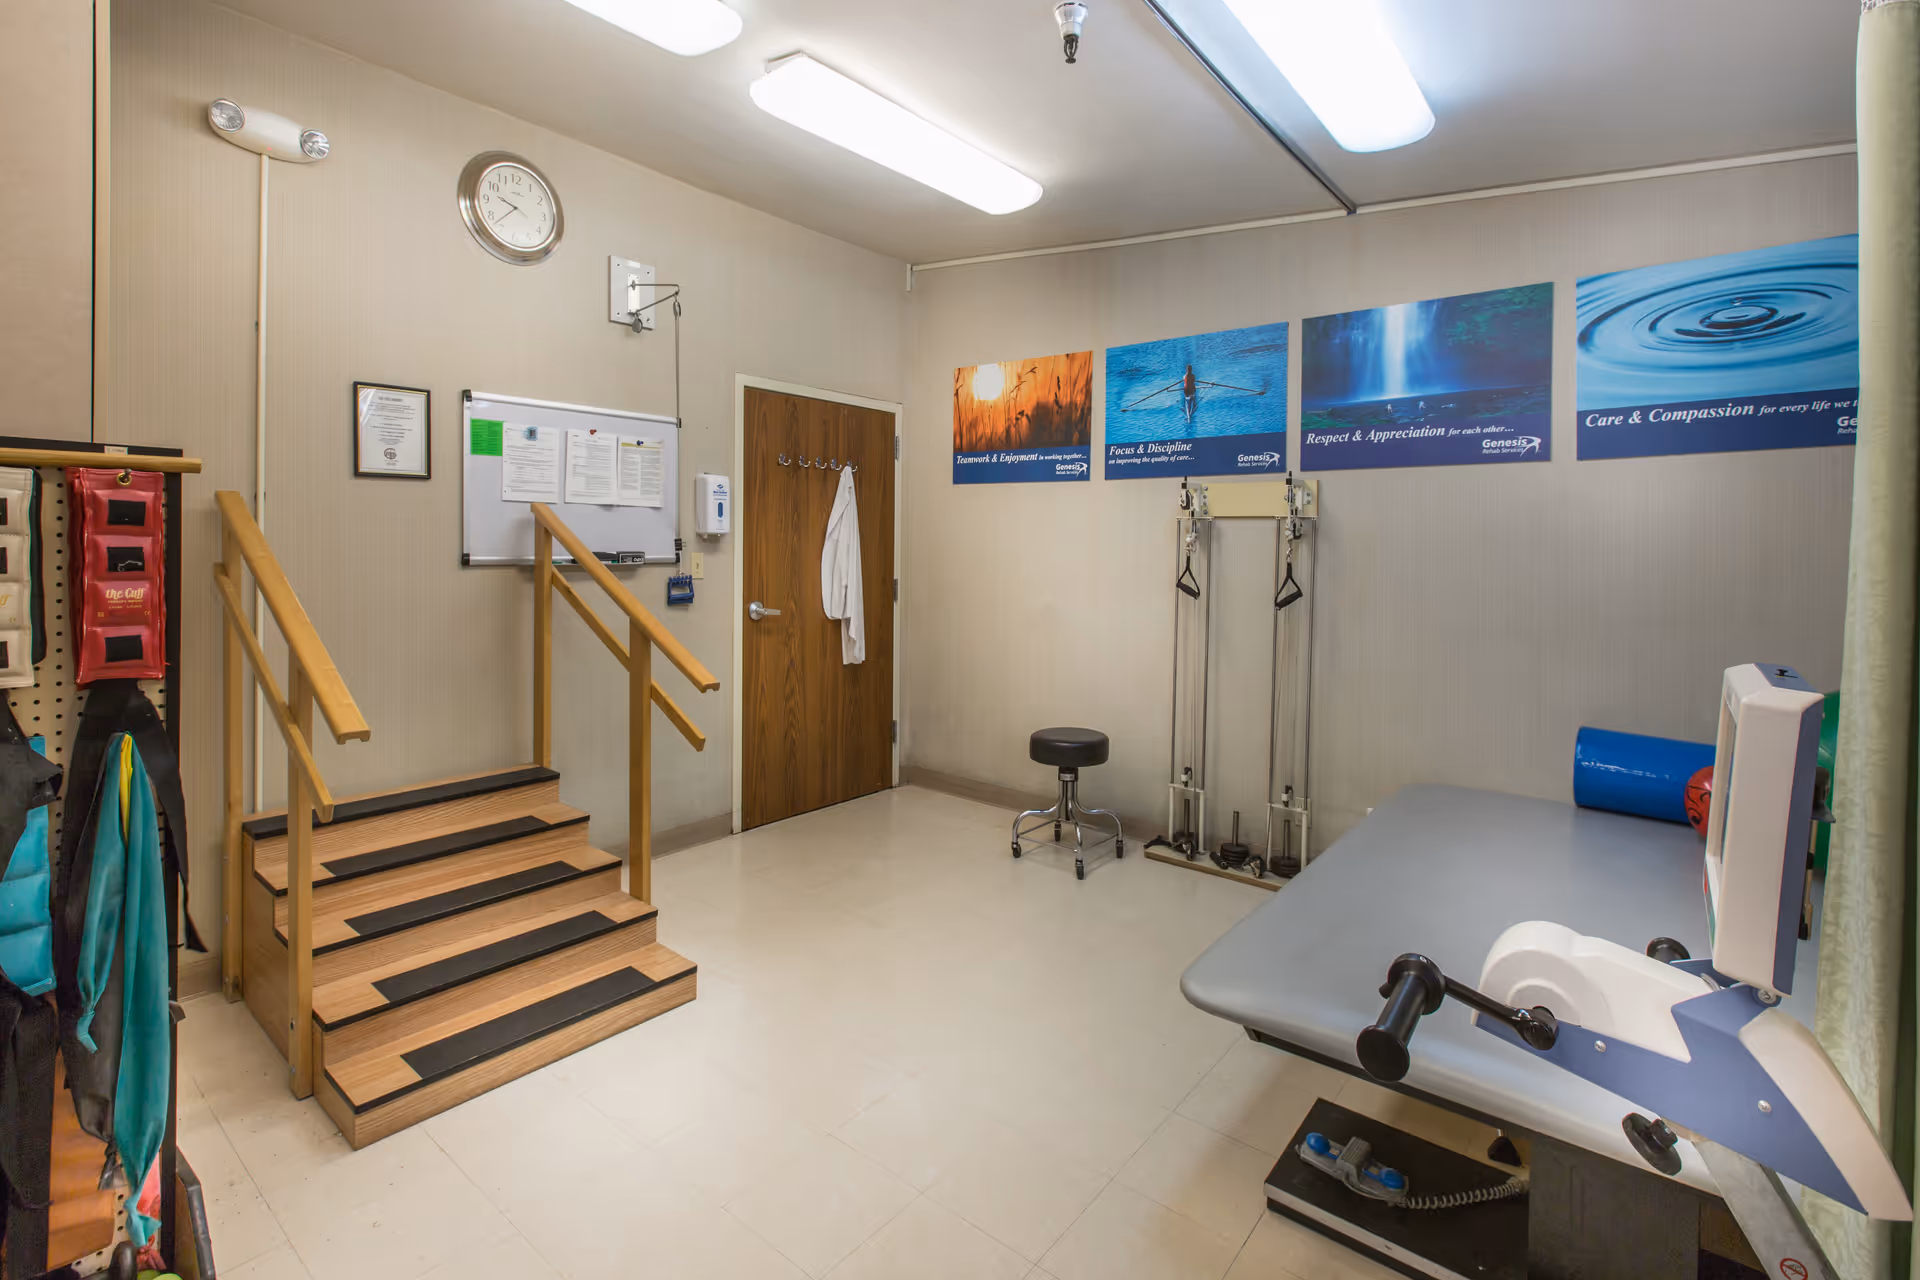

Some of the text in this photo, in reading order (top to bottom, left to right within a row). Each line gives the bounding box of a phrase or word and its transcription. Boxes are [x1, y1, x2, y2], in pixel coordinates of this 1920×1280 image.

[497, 173, 508, 185] 11
[510, 173, 522, 186] 12
[488, 181, 500, 193] 10
[482, 193, 490, 204] 9
[537, 195, 543, 206] 2
[487, 210, 495, 221] 8
[541, 212, 547, 222] 3
[535, 226, 541, 235] 4
[1585, 413, 1624, 428] Care
[1628, 410, 1643, 424] &
[1648, 403, 1754, 423] Compassion
[1757, 405, 1777, 416] for
[1779, 404, 1809, 413] every
[1811, 400, 1832, 412] life
[1834, 400, 1850, 408] we
[1306, 432, 1350, 446] Respect
[1352, 430, 1362, 441] &
[1365, 425, 1446, 443] Appreciation
[1446, 428, 1461, 437] for
[1462, 426, 1481, 434] each
[1109, 441, 1192, 456] Focus & Discipline
[1482, 439, 1528, 448] Genesis
[956, 454, 990, 464] Teamwork
[991, 453, 998, 463] &
[999, 452, 1038, 464] Enjoyment
[1044, 453, 1063, 461] working
[1115, 457, 1142, 466] improving
[1150, 455, 1169, 464] quality
[1169, 455, 1177, 463] of
[1237, 453, 1271, 462] Genesis
[1055, 463, 1081, 471] Genesis
[105, 587, 144, 600] the Cuff
